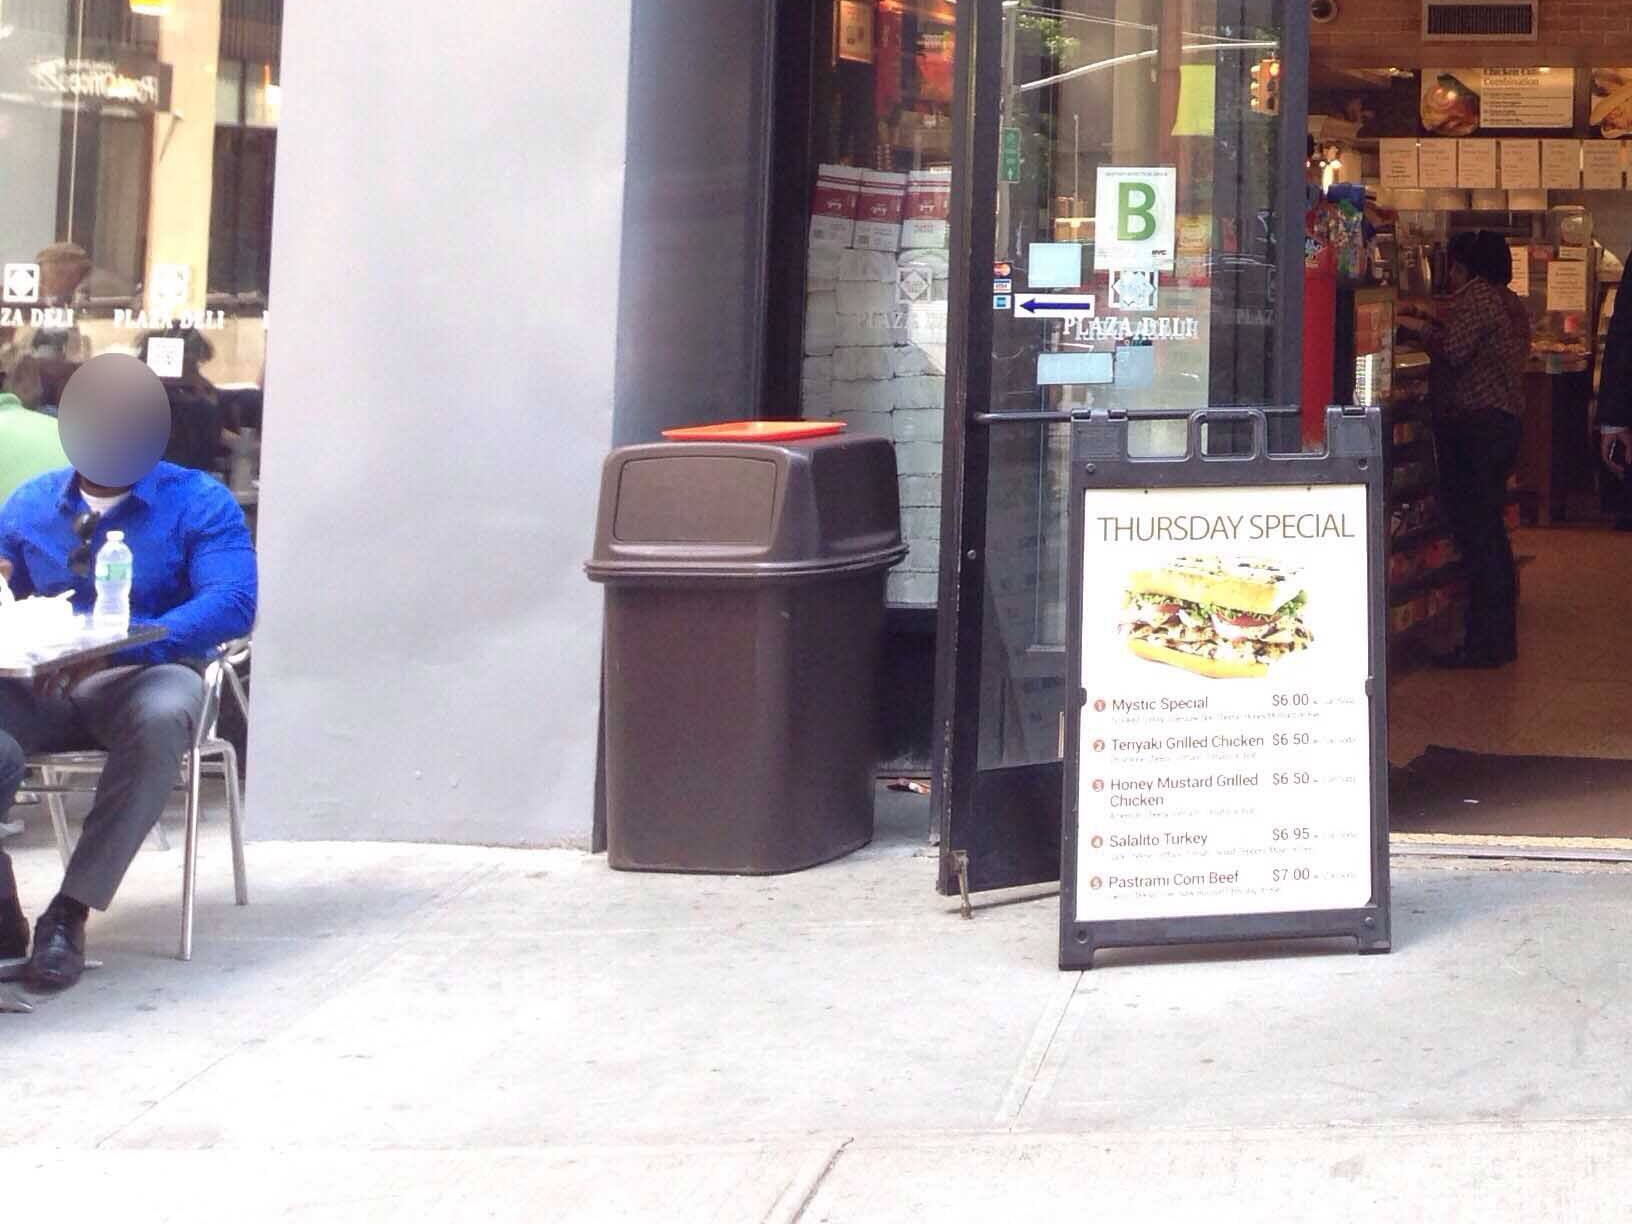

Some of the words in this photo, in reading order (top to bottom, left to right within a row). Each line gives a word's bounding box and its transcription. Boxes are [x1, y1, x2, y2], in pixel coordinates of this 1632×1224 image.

[1117, 182, 1156, 241] B
[30, 308, 74, 328] DELI
[113, 309, 175, 329] PLAZA
[180, 309, 225, 330] DELI
[1062, 317, 1132, 336] PLAZA
[1140, 317, 1197, 337] DELI
[1097, 516, 1244, 542] THURSDAY
[1249, 513, 1355, 540] SPECIAL
[1112, 698, 1157, 714] Mystic
[1160, 696, 1208, 712] Special
[1272, 693, 1309, 707] $600
[1112, 738, 1162, 754] Teriyaki
[1166, 736, 1208, 749] Grilled
[1211, 734, 1264, 748] Chicken
[1272, 733, 1310, 746] $650
[1111, 778, 1153, 792] Honey
[1157, 776, 1213, 789] Mustard
[1216, 773, 1258, 787] Grilled
[1272, 772, 1310, 785] $650
[1110, 793, 1164, 807] Chicken
[1163, 832, 1208, 846] Turkey
[1272, 828, 1310, 841] $695
[1109, 876, 1170, 889] Pastrami
[1209, 870, 1239, 884] Beef
[1272, 868, 1310, 882] $700
